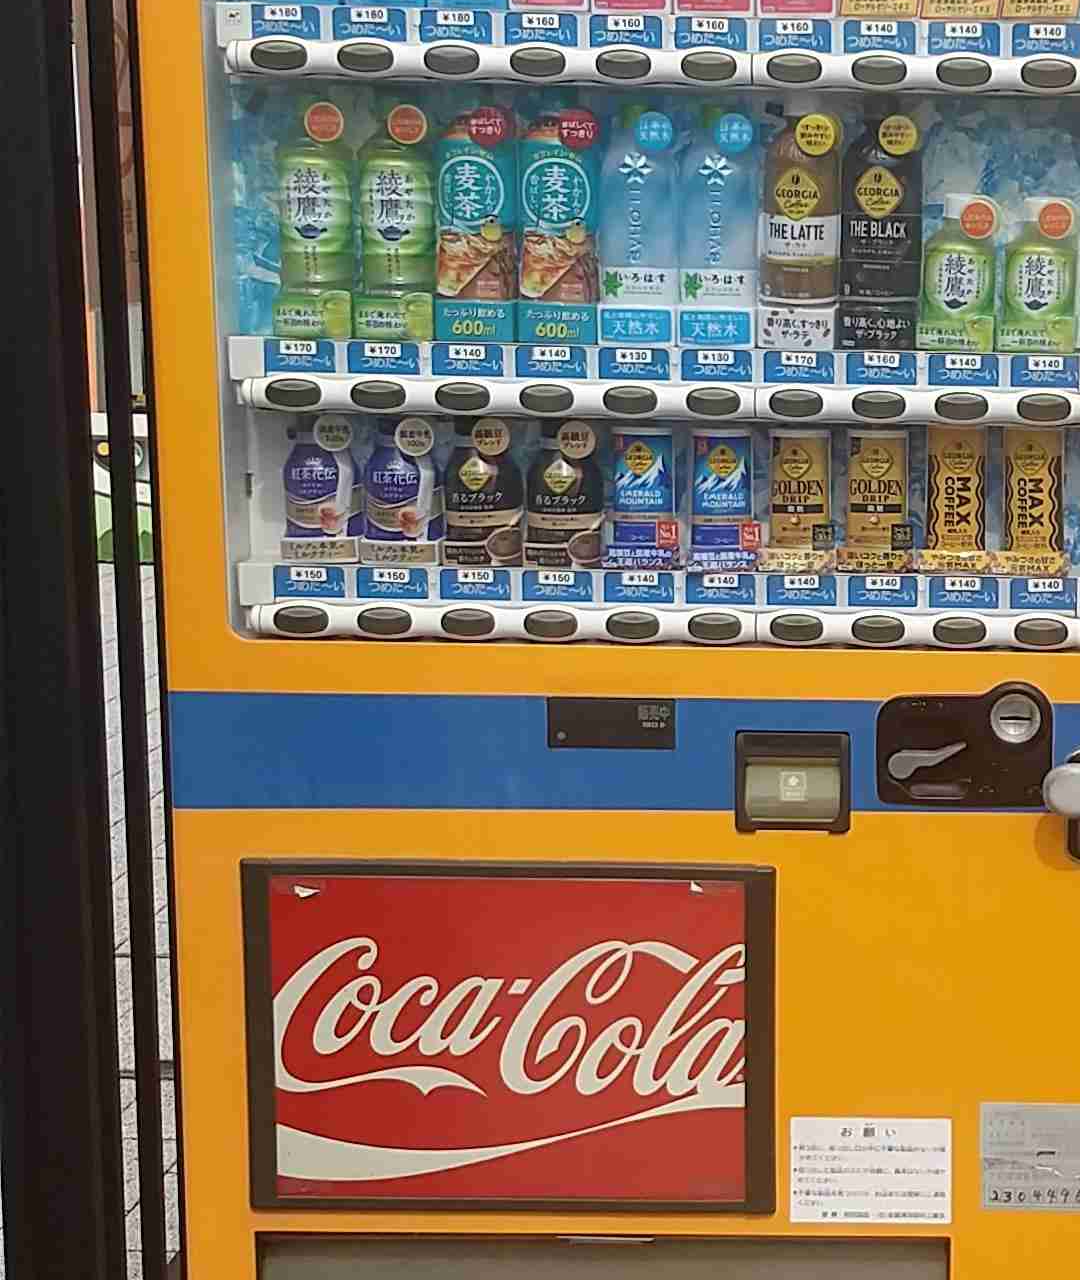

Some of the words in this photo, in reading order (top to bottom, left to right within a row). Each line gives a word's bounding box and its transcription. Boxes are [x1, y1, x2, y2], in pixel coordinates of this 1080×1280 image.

[527, 17, 555, 26] ¥160
[613, 19, 641, 28] ¥160
[697, 20, 724, 30] ¥160
[865, 24, 893, 33] ¥140
[950, 25, 977, 34] ¥140
[1034, 27, 1062, 36] ¥140
[453, 163, 484, 219] 麦茶
[541, 165, 572, 221] 麦茶
[776, 186, 819, 199] GEORGIA
[856, 186, 900, 198] GEORGIA
[768, 223, 788, 240] THE
[790, 223, 825, 240] LATTE
[850, 221, 869, 237] THE
[871, 221, 908, 238] BLACK
[454, 348, 481, 357] ¥140
[539, 350, 566, 359] ¥140
[785, 355, 813, 365] ¥170
[950, 358, 977, 367] ¥140
[1032, 359, 1060, 368] ¥140
[772, 479, 824, 497] GOLDEN
[849, 479, 903, 496] GOLDEN
[944, 477, 955, 527] COFFEE
[956, 476, 971, 526] MAX
[1017, 478, 1028, 528] COFFEE
[1028, 478, 1044, 527] MAX
[628, 574, 654, 583] ¥140
[708, 576, 734, 585] ¥140
[789, 578, 815, 587] ¥140
[871, 578, 897, 587] ¥140
[950, 579, 976, 589] ¥140
[1033, 580, 1059, 589] ¥140
[273, 936, 746, 1097] Coca-Cola
